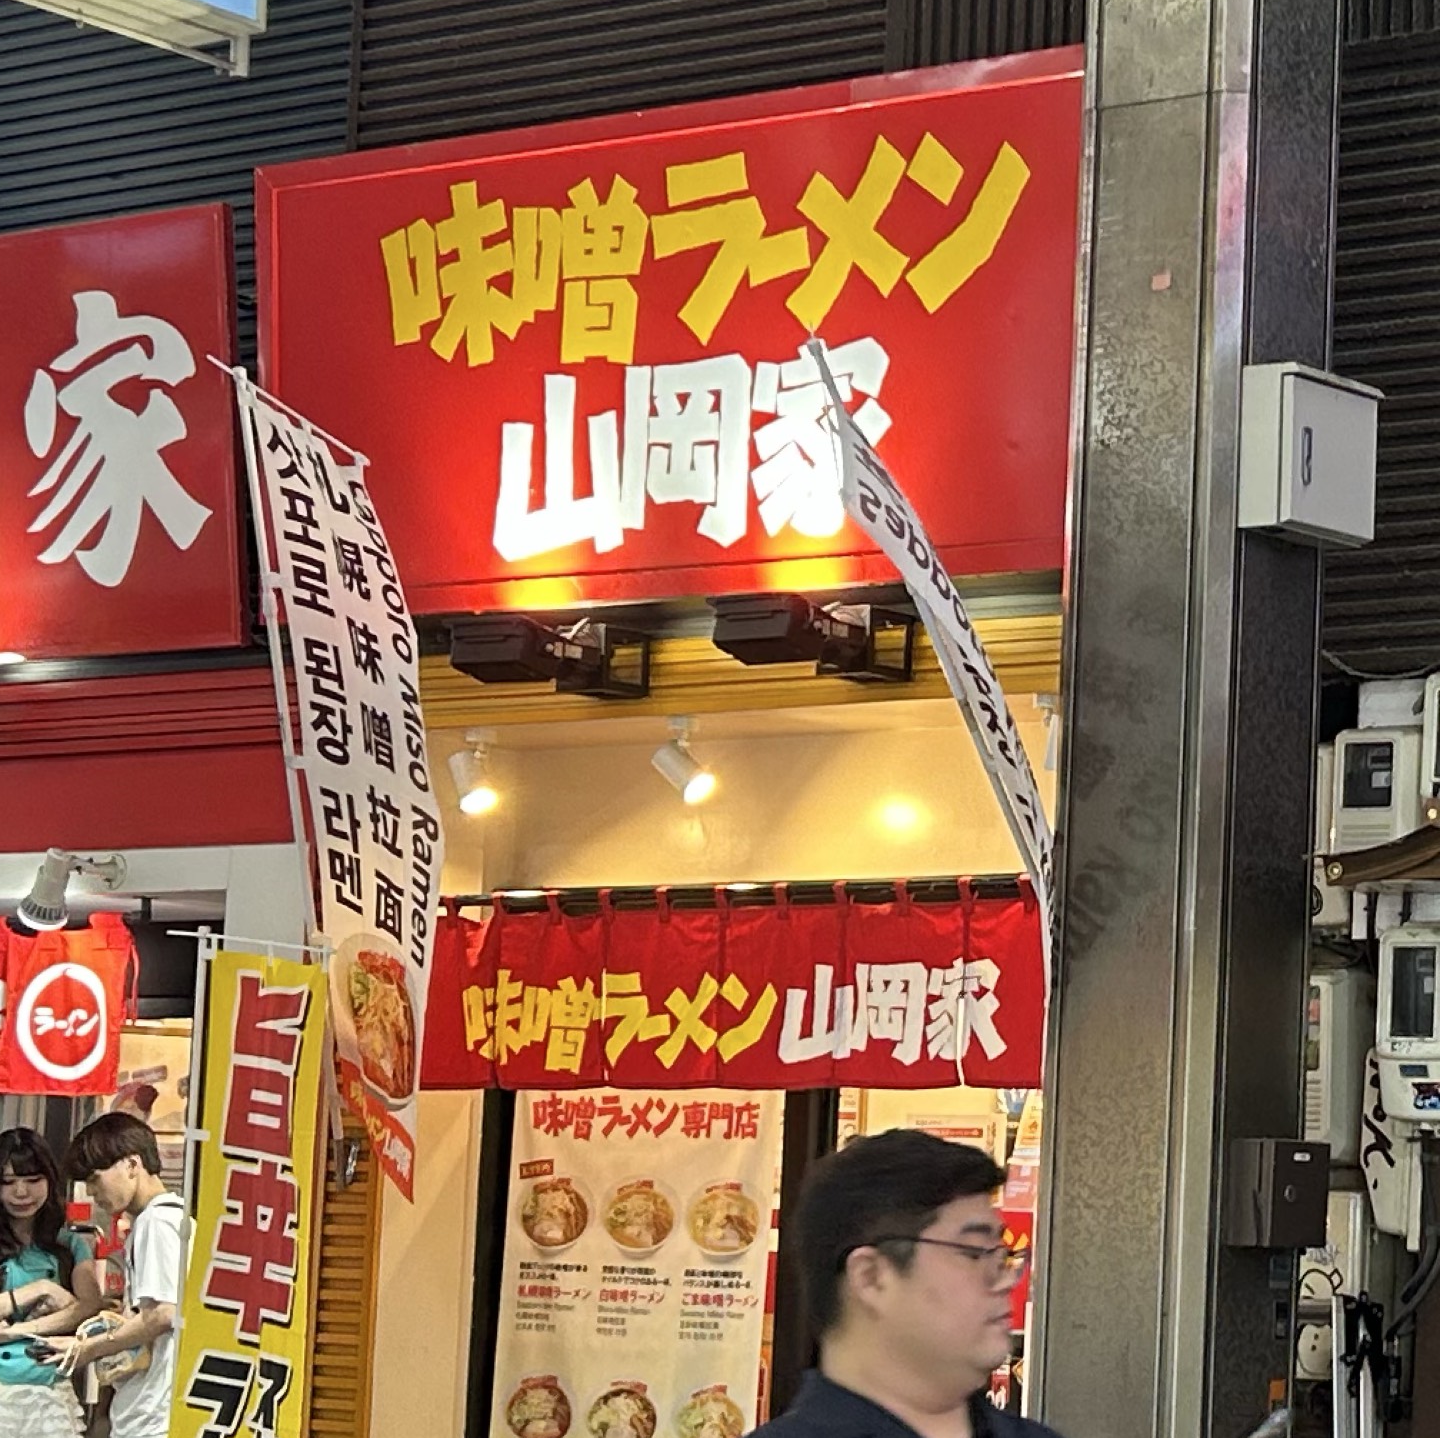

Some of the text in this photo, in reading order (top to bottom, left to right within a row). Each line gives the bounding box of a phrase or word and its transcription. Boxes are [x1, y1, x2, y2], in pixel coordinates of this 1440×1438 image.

[379, 131, 1033, 366] 味噌ラーメン
[493, 336, 893, 562] 山岡家
[266, 422, 364, 917] 삿포로 된장 라멘
[410, 802, 440, 969] Ramen
[201, 968, 312, 1347] 旨辛
[531, 1091, 762, 1143] 味噌ラーメン専門店
